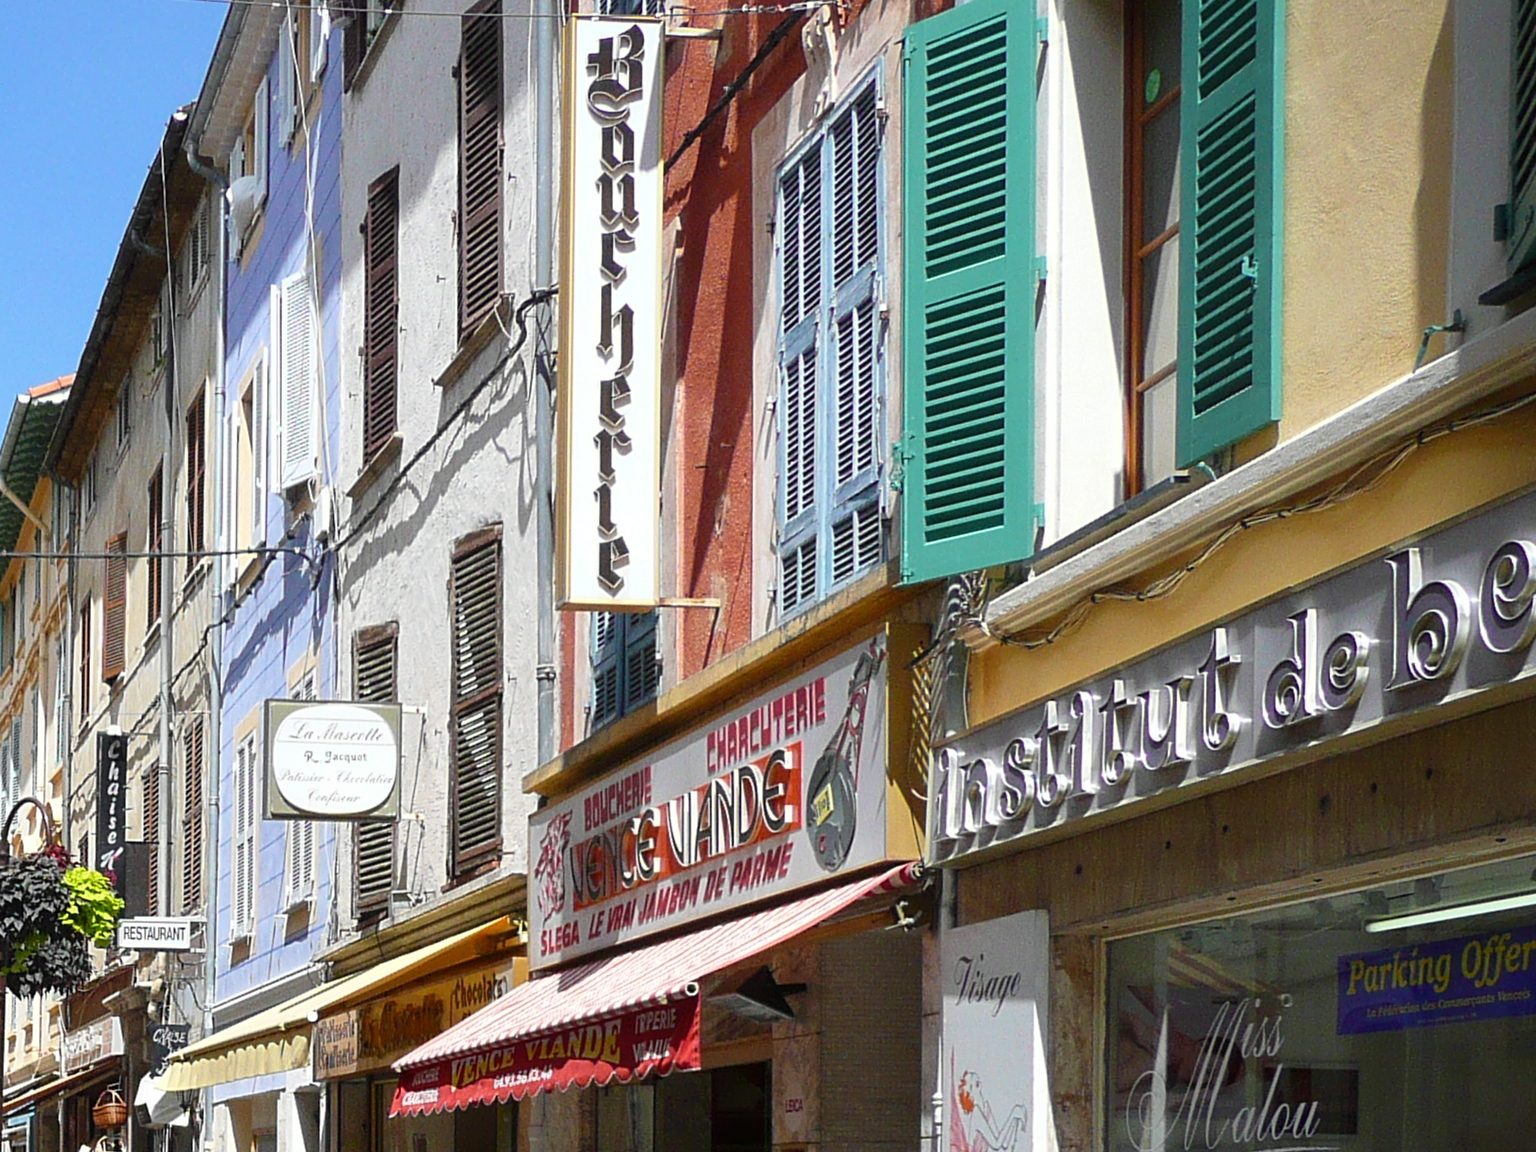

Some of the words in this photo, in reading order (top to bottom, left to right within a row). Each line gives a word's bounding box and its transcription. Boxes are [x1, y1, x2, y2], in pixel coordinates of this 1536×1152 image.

[586, 24, 646, 597] Boucherie
[288, 721, 314, 740] La
[325, 750, 368, 764] Jacquot
[583, 766, 652, 831] BOUCHERIE
[706, 677, 826, 772] CHARCUTERIE
[935, 628, 1244, 842] institut
[1263, 608, 1370, 729] de
[107, 739, 121, 844] Chaise
[570, 806, 662, 902] VENCE
[588, 906, 605, 939] LE
[606, 895, 636, 932] VRAI
[637, 877, 701, 926] JAMBON
[702, 866, 728, 903] DE
[729, 841, 794, 895] PARME
[123, 926, 186, 943] RESTAURANT
[1346, 947, 1452, 995] Parking
[953, 953, 1022, 1017] Visage
[1422, 1000, 1436, 1012] des
[451, 1047, 515, 1093] VENCE
[525, 1018, 622, 1065] VIANDE
